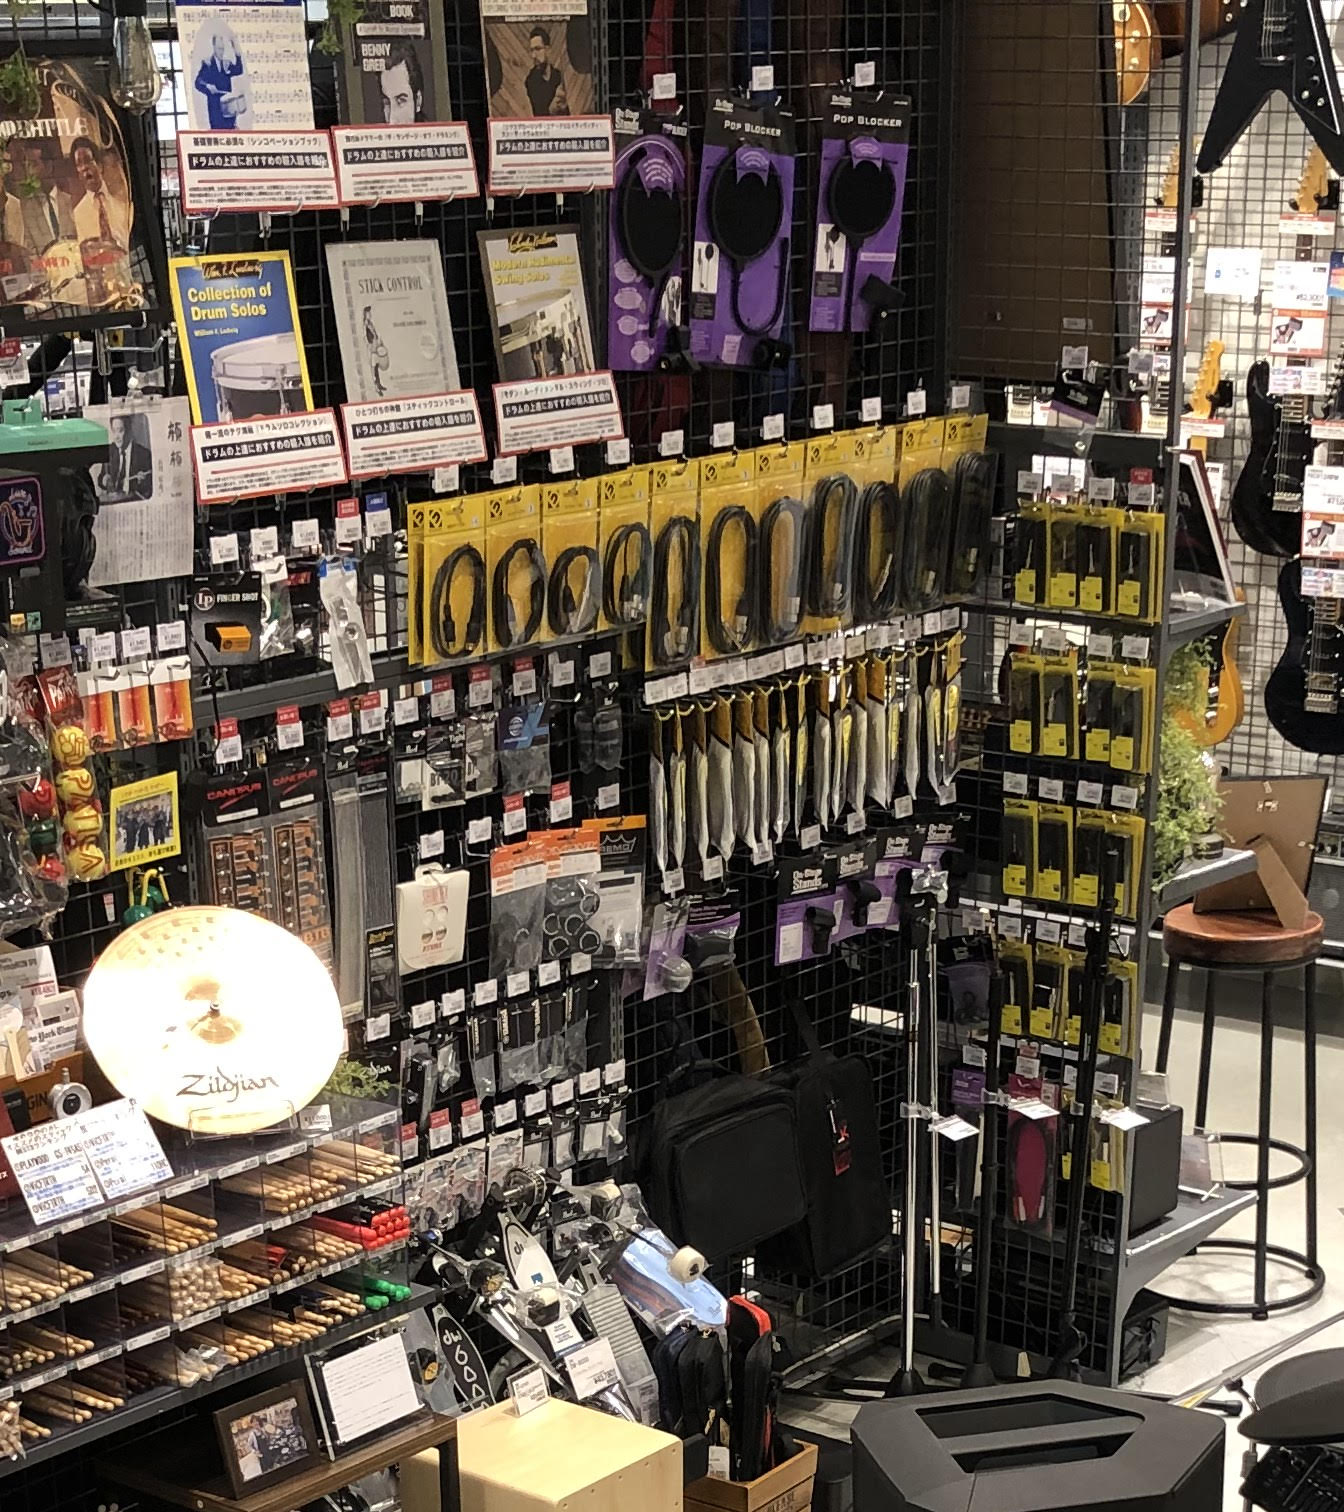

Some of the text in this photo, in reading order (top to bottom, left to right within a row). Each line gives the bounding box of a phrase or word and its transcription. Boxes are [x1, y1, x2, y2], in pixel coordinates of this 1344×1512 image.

[361, 43, 392, 57] BENNY
[724, 119, 782, 138] POP BLOCKER
[833, 114, 903, 128] POP BLOCKER
[187, 282, 273, 305] Collection of
[358, 275, 424, 294] STICK CONTROL
[190, 302, 267, 322] Drum Solos
[176, 1065, 281, 1103] Zildjian
[442, 1329, 462, 1345] dw
